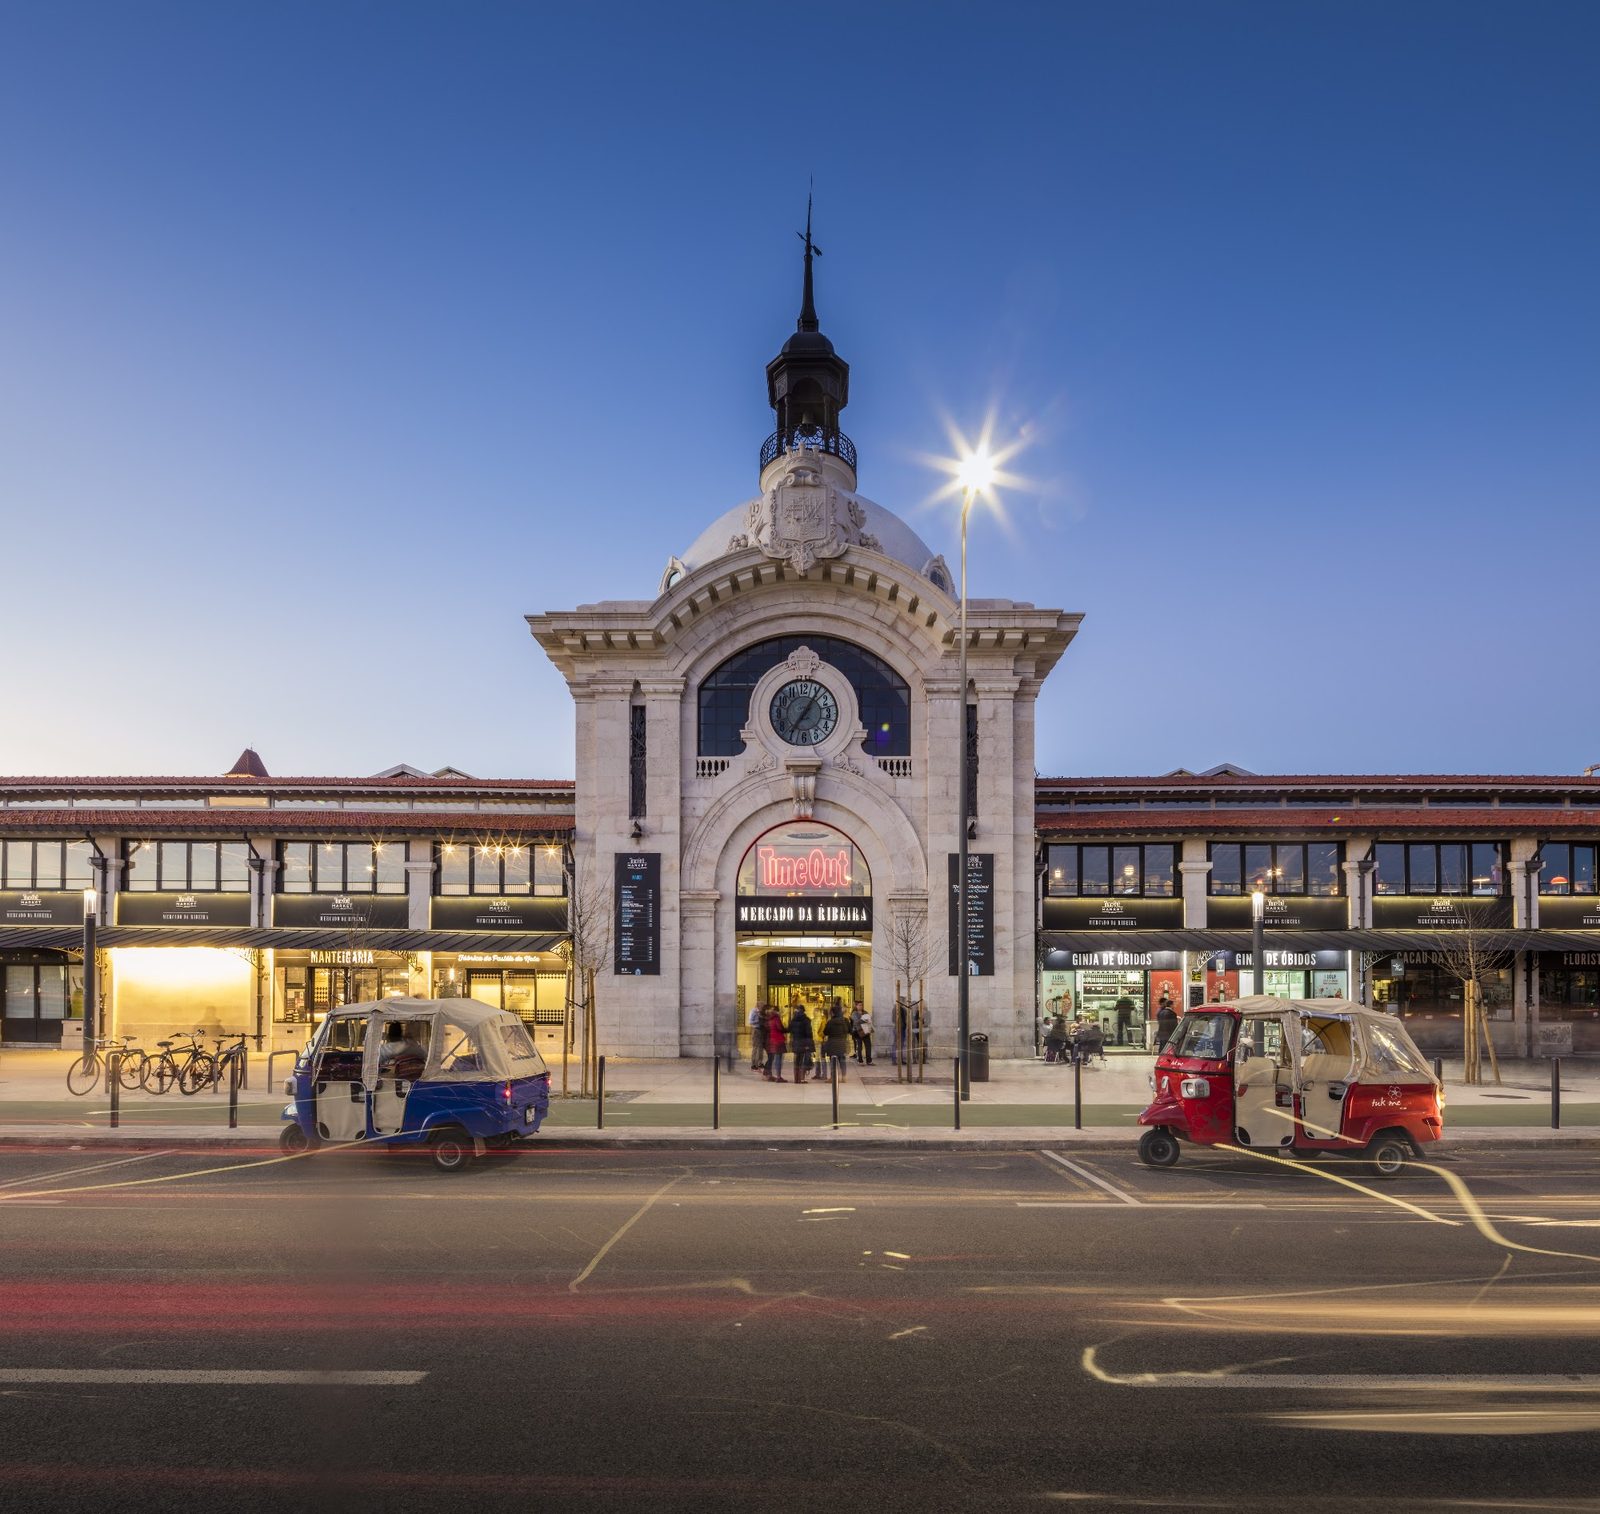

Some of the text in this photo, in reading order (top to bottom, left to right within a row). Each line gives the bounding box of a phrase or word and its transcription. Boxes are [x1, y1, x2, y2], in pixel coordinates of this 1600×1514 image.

[789, 686, 795, 698] 11
[800, 683, 808, 695] 12
[779, 695, 788, 707] 10
[823, 695, 828, 706] 2
[826, 707, 831, 719] 3
[823, 721, 829, 731] 4
[801, 732, 807, 743] 6
[740, 906, 867, 922] MERCADO DA RIBEIRA
[1072, 951, 1152, 966] GINJA DE ÓBIDOS
[1236, 951, 1316, 966] GIN DE ÓBIDOS
